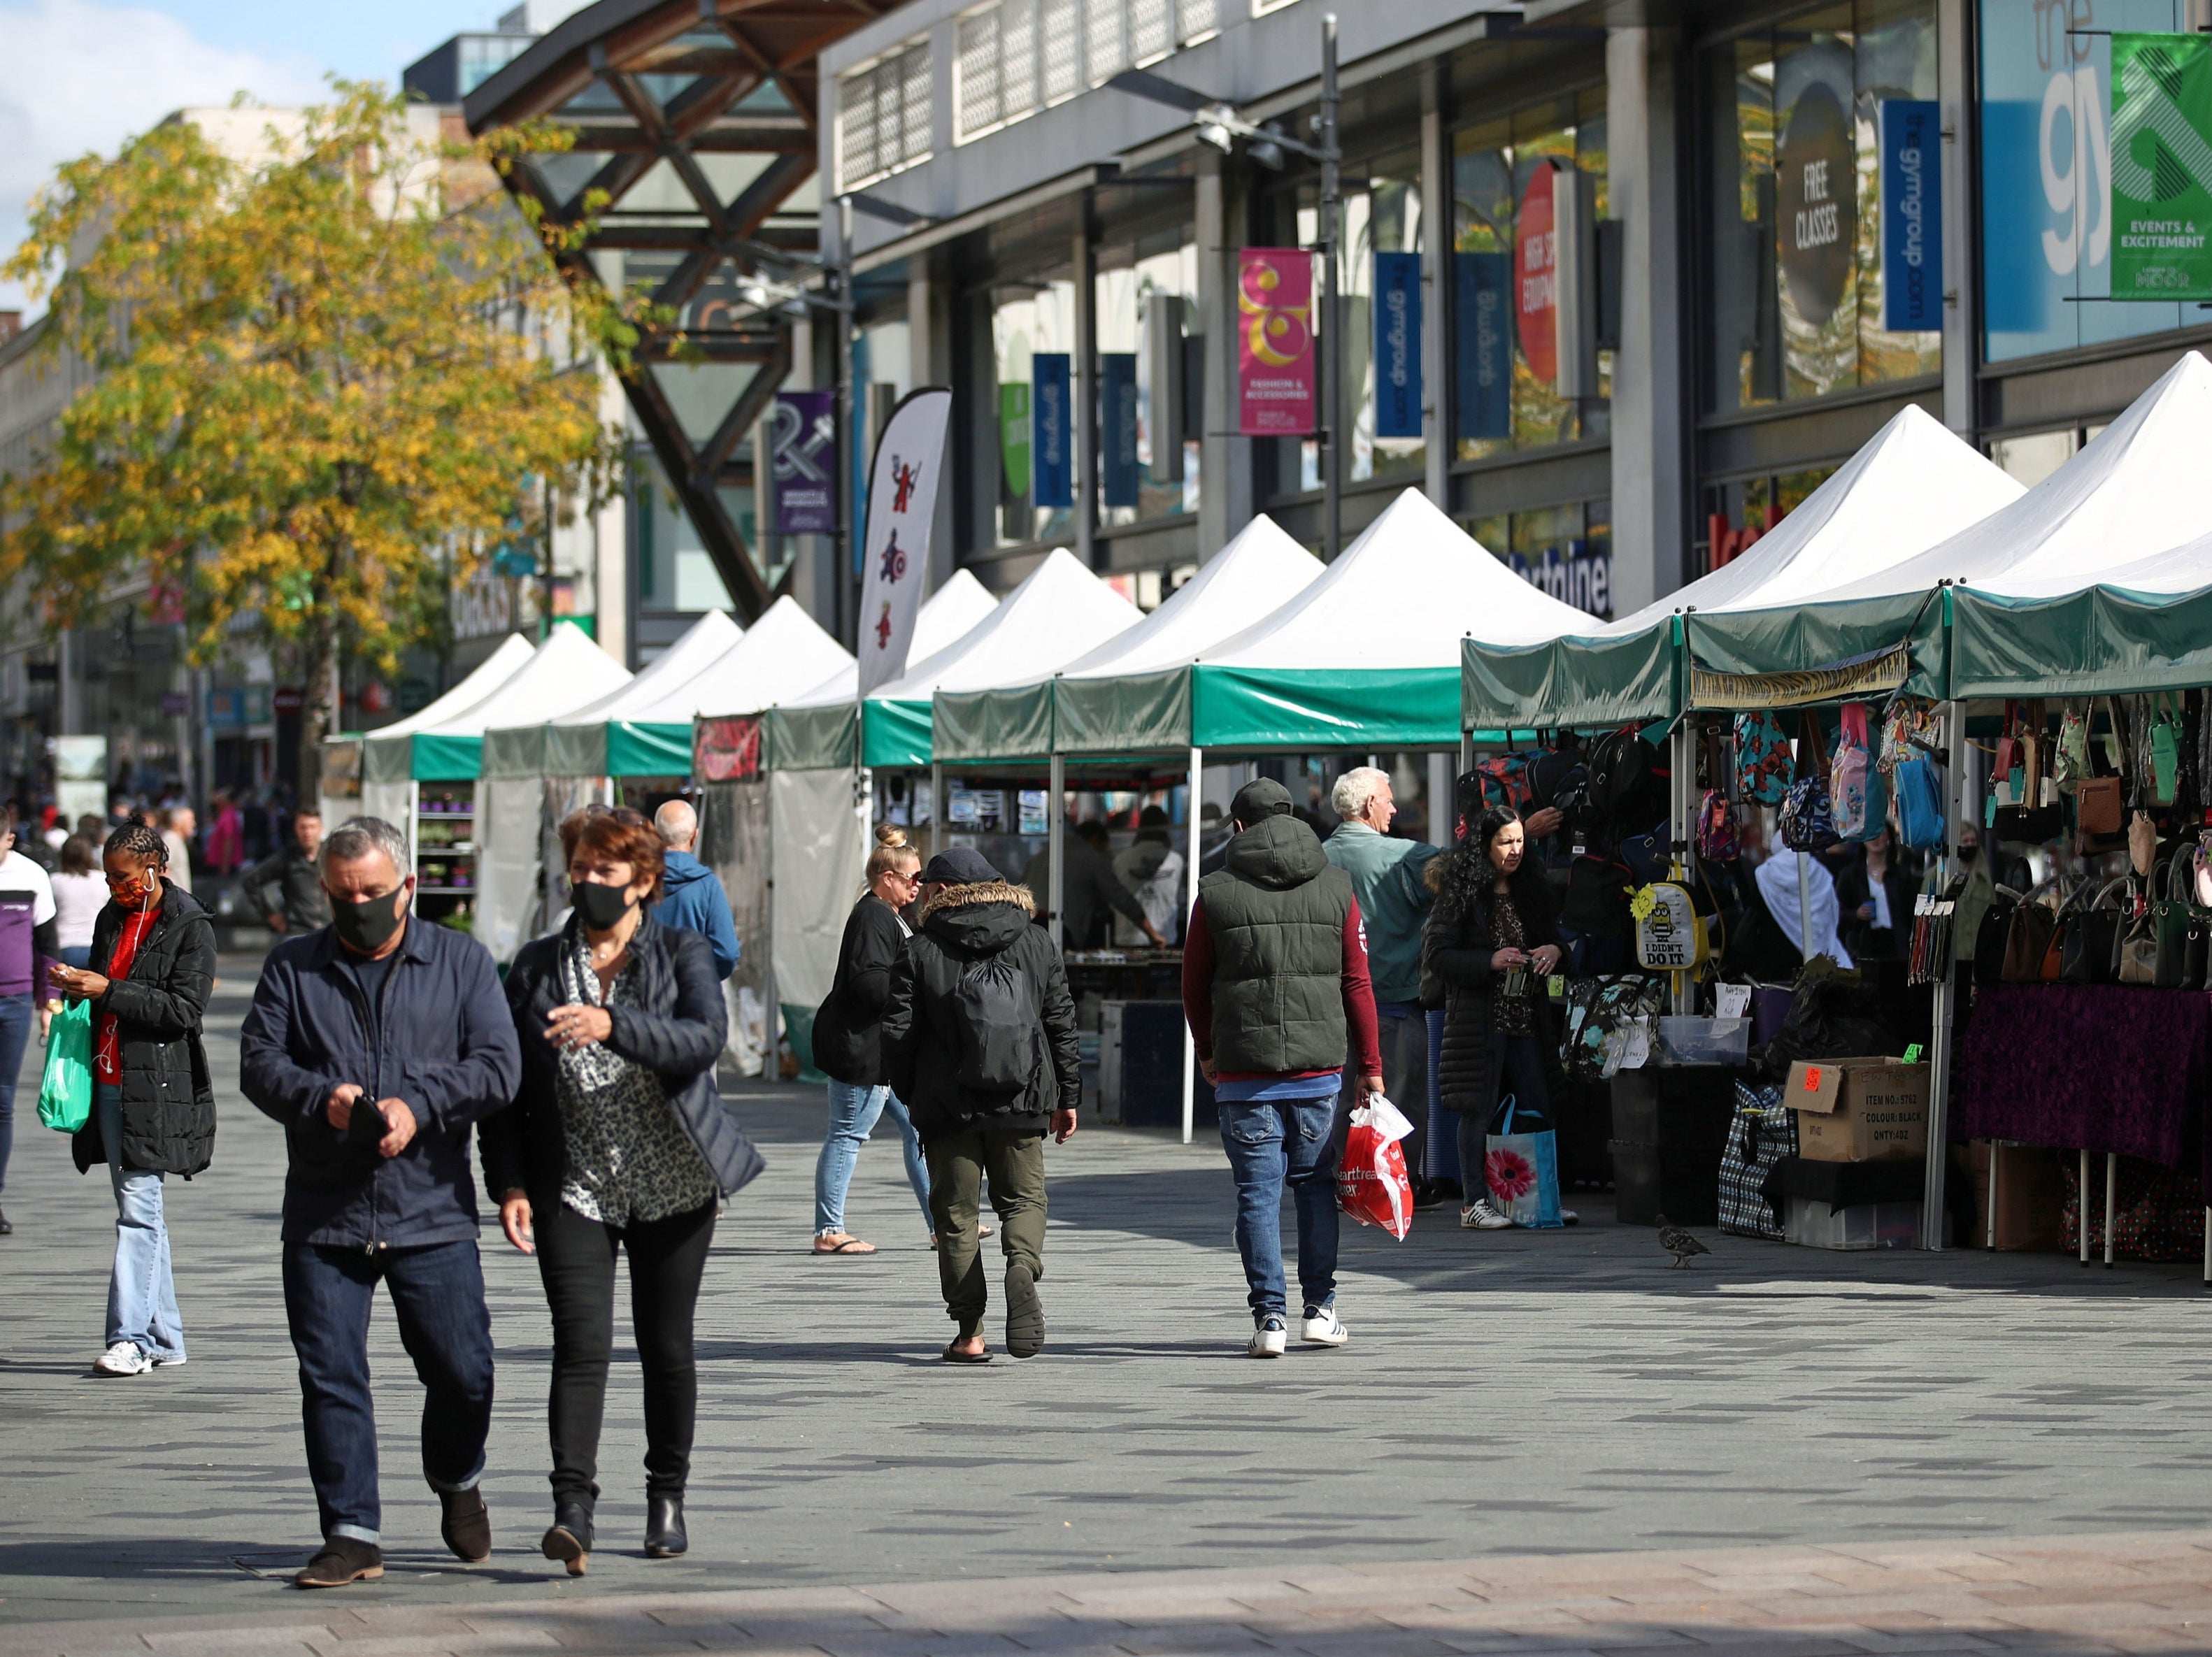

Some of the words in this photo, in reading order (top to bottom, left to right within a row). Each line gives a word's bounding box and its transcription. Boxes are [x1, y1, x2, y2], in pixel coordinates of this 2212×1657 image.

[1804, 159, 1827, 203] FREE
[1795, 203, 1838, 250] CLASSES
[2130, 221, 2181, 233] EVENTS
[2185, 221, 2195, 233] &
[2121, 236, 2204, 248] EXCITEMENT
[1637, 895, 1650, 913] £3
[1646, 943, 1649, 952] I
[1652, 944, 1683, 952] DIDN'T
[1646, 953, 1667, 965] DO
[1669, 953, 1684, 965] IT
[1866, 1095, 1883, 1105] ITEM
[1900, 1094, 1917, 1105] 5762
[1866, 1112, 1897, 1123] COLOUR:
[1899, 1112, 1922, 1122] BLACK
[1874, 1130, 1908, 1141] QNTY:4DZ
